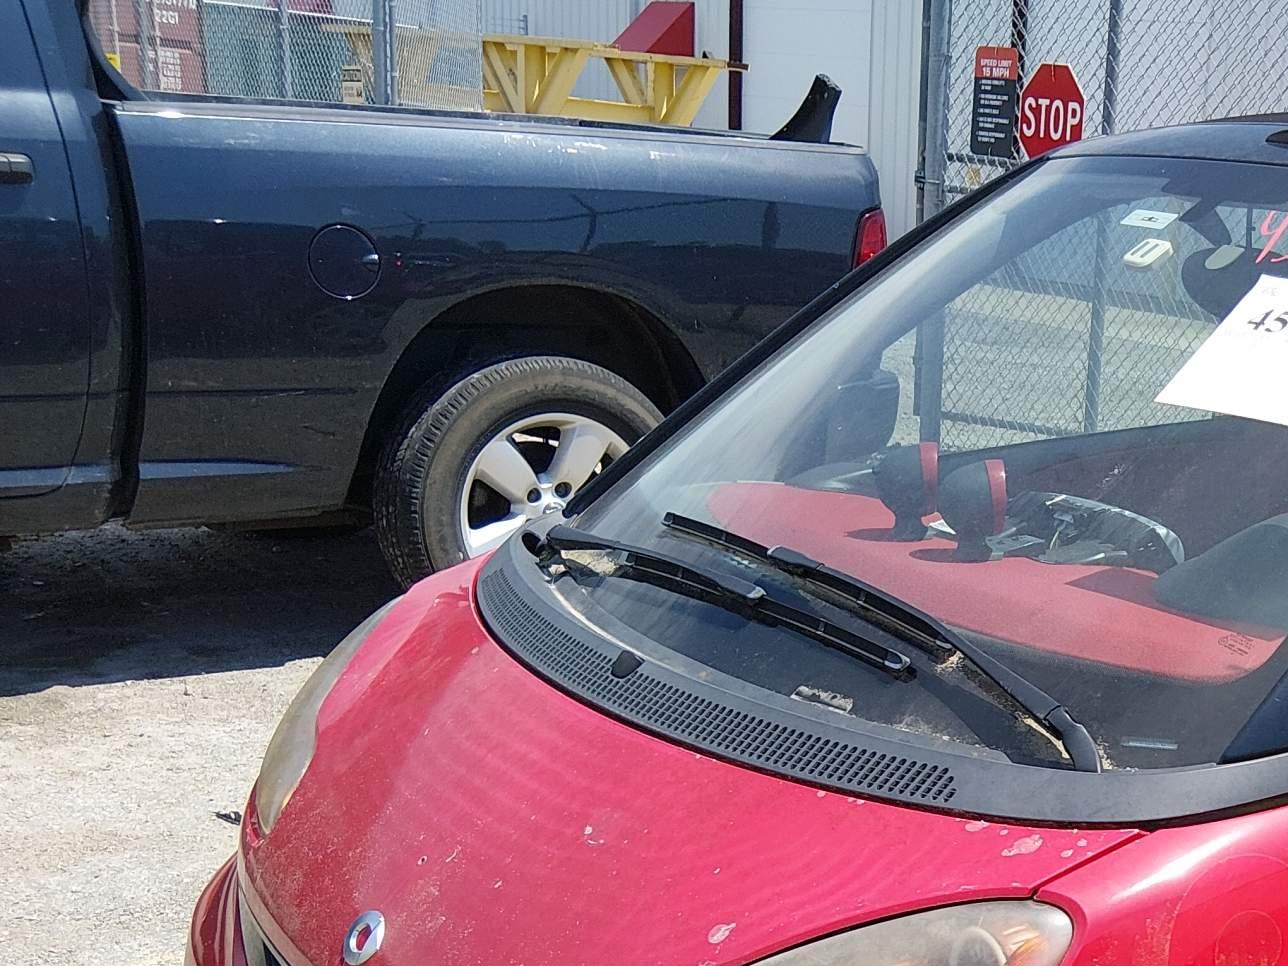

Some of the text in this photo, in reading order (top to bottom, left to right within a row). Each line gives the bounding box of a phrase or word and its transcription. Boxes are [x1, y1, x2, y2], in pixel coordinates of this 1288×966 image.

[980, 58, 1013, 68] SPEED LIMIT
[982, 67, 1010, 79] 15 MPH
[1022, 96, 1081, 142] STOP
